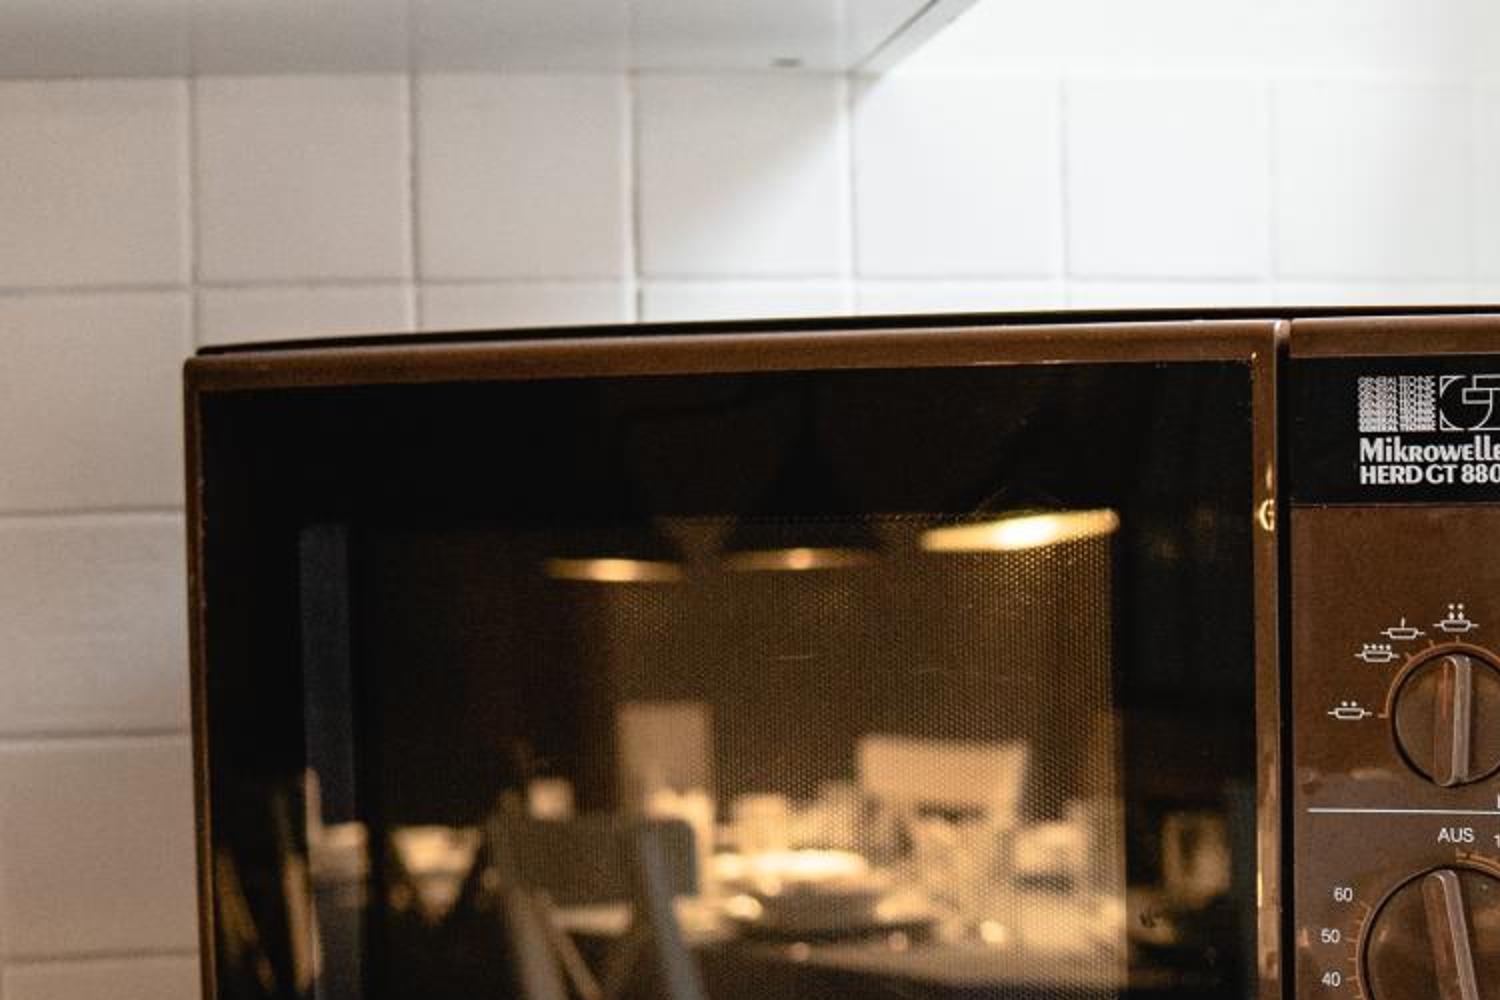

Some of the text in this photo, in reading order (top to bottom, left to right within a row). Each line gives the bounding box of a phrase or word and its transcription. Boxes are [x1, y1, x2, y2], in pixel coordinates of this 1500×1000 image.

[1360, 465, 1423, 485] HERD
[1425, 464, 1458, 484] GT
[1437, 828, 1474, 843] AUS
[1334, 887, 1353, 902] 60
[1321, 929, 1341, 944] 50
[1321, 972, 1341, 987] 40
